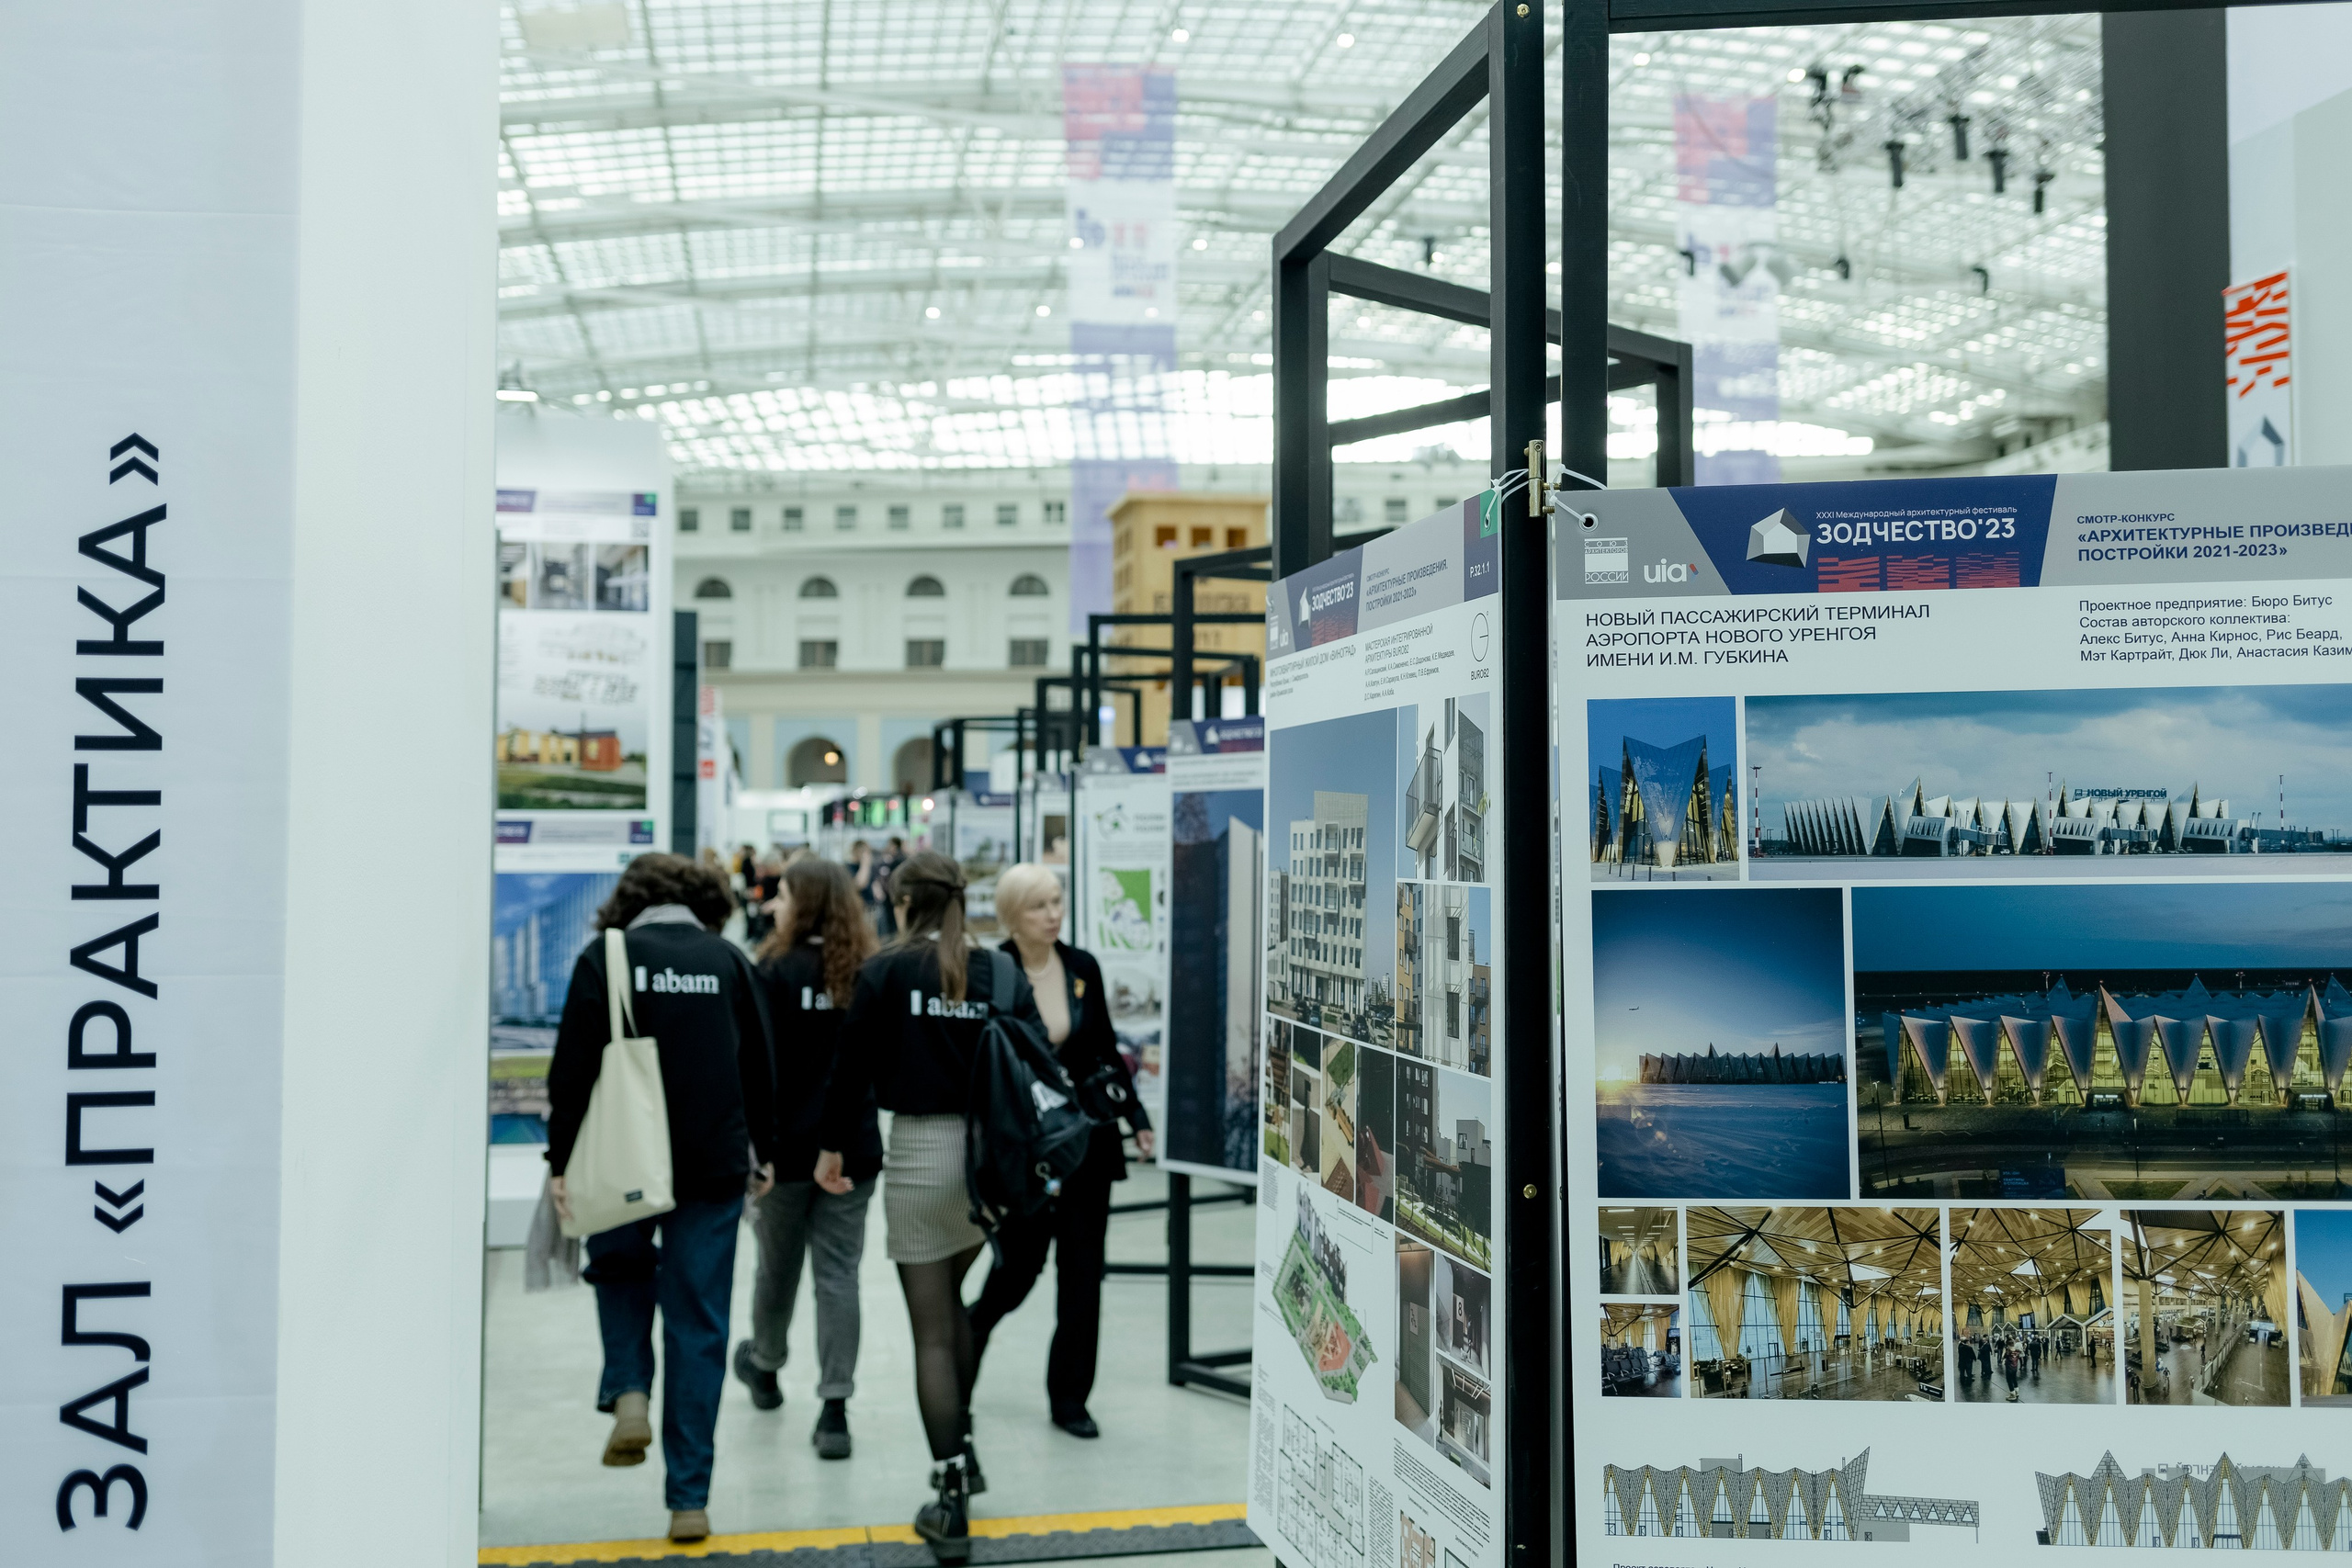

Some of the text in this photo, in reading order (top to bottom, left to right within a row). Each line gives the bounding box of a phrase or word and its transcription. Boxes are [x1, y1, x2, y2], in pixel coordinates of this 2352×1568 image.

[1816, 505, 2018, 520] XXXI Международный архитектурный фестиваль
[2076, 513, 2176, 524] СМОТР-КОНКУРС
[1816, 518, 2016, 546] ЗОДЧЕСТВО'23
[2078, 522, 2352, 543] «АРХИТЕКТУРНЫЕ ПРОИЗВЕД
[2078, 543, 2288, 561] ПОСТРОЙКИ 2021-2023»
[1366, 573, 1406, 596] «АРХИТЕКТУРНЫЕ
[1407, 558, 1448, 581] ПРОИЗВЕДЕНИЯ.
[1585, 571, 1628, 582] РОССИИ
[1644, 558, 1687, 583] uia
[1365, 594, 1392, 612] ПОСТРОЙКИ
[2079, 595, 2333, 614] Проектное предприятие: Бюро Битус
[1586, 604, 1929, 626] НОВЫЙ ПАССАЖИРСКИЙ ТЕРМИНАЛ
[2080, 614, 2290, 628] Состав авторского коллектива:
[1365, 623, 1433, 651] МАСТЕРСКАЯ ИНТЕГРИРОВАННОЙ
[1586, 626, 1876, 647] АЭРОПОРТА НОВОГО УРЕНГОЯ
[2080, 628, 2343, 647] Алекс Битус, Анна Кирнос, Рис Беард,
[1587, 649, 1789, 667] ИМЕНИ И.М. ГУБКИНА
[2081, 650, 2106, 661] Мэт
[2110, 649, 2175, 662] Картрайт,
[2179, 649, 2207, 660] Дюк
[2211, 647, 2233, 660] Ли,
[2237, 646, 2308, 658] Анастасия
[2087, 787, 2166, 797] НОВЫЙ УРЕНГОЙ
[55, 432, 168, 1534] ЗАЛ «ПРАКТИКА»
[652, 967, 719, 994] abam
